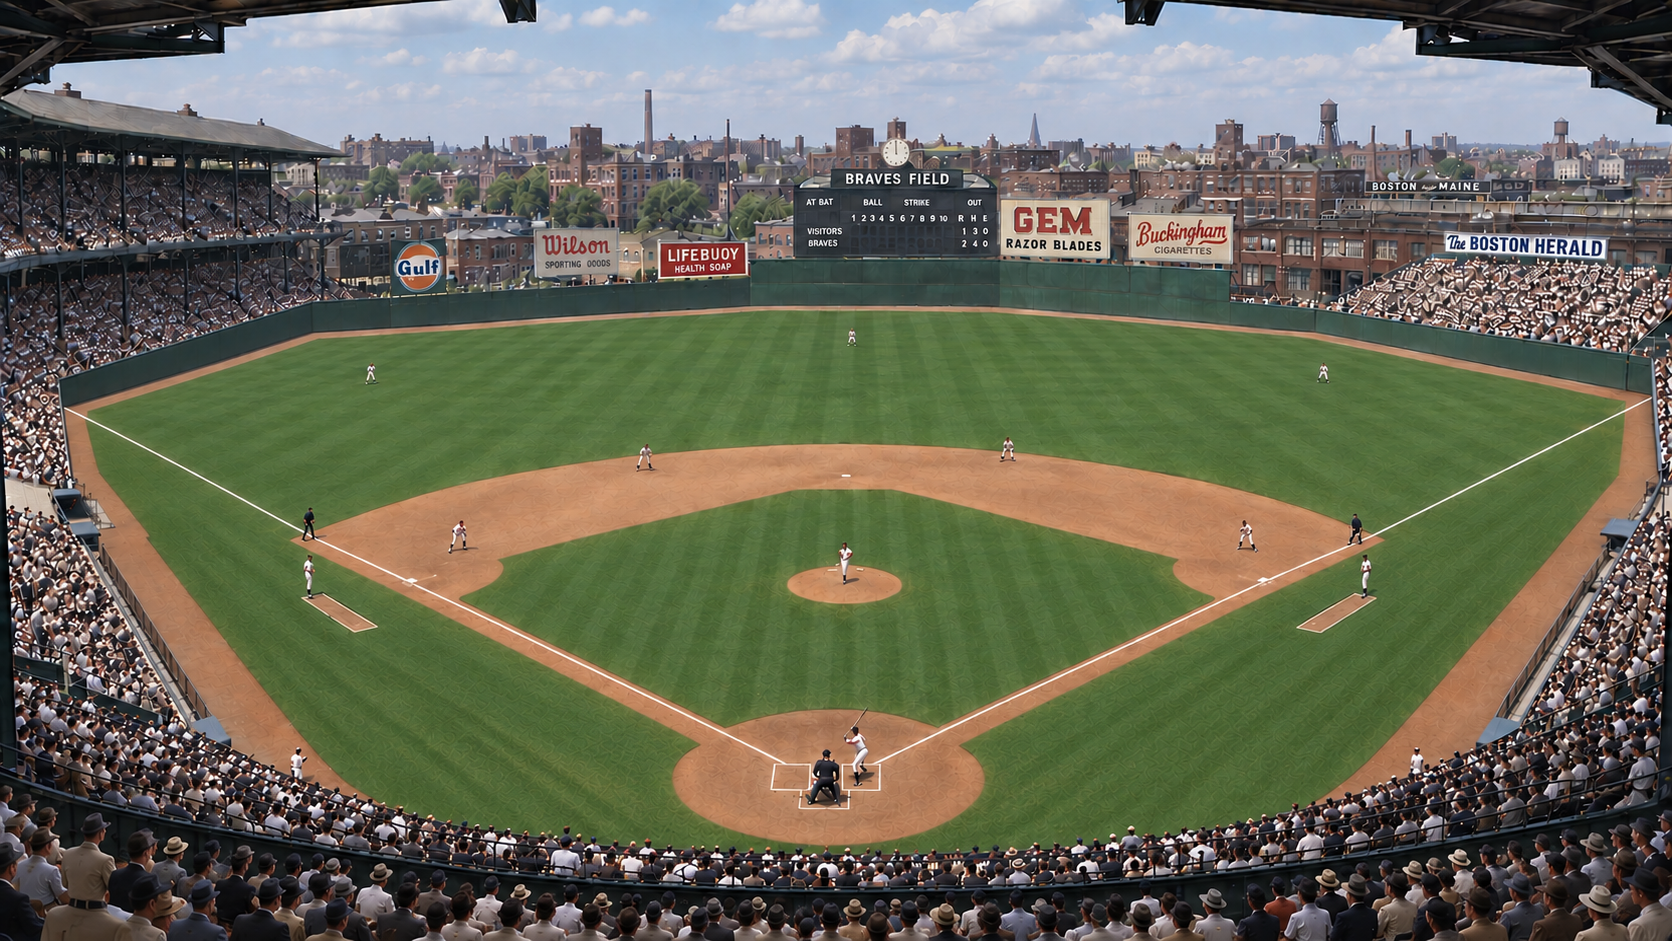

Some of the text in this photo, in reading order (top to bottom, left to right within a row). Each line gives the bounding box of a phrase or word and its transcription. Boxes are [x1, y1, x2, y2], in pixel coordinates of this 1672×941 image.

[845, 172, 950, 185] BRAVES FIELD
[1372, 182, 1417, 191] BOSTON
[1438, 182, 1480, 191] MAINE
[806, 198, 834, 206] AT BAT
[863, 199, 883, 207] BALL
[903, 199, 930, 207] STRIKE
[967, 199, 983, 207] OUT
[851, 214, 949, 222] 1 2 3 4 5 6 7 8 9 10
[958, 214, 988, 222] R H E
[1013, 206, 1093, 236] GEM
[807, 227, 843, 236] VISITORS
[962, 227, 967, 235] 1
[972, 227, 978, 235] 3
[1135, 219, 1229, 247] Buckingham
[542, 234, 610, 256] Wilson
[808, 239, 838, 248] BRAVES
[961, 239, 967, 248] 2
[972, 239, 978, 248] 4
[1006, 238, 1102, 252] RAZOR BLADES
[1447, 235, 1604, 257] The BOSTON HERALD
[668, 246, 740, 263] LIFEBUOY
[1154, 246, 1213, 257] CIGARETTES
[398, 259, 439, 276] Gulf
[545, 260, 582, 269] SPORTING
[674, 262, 733, 274] HEALTH SOAP
